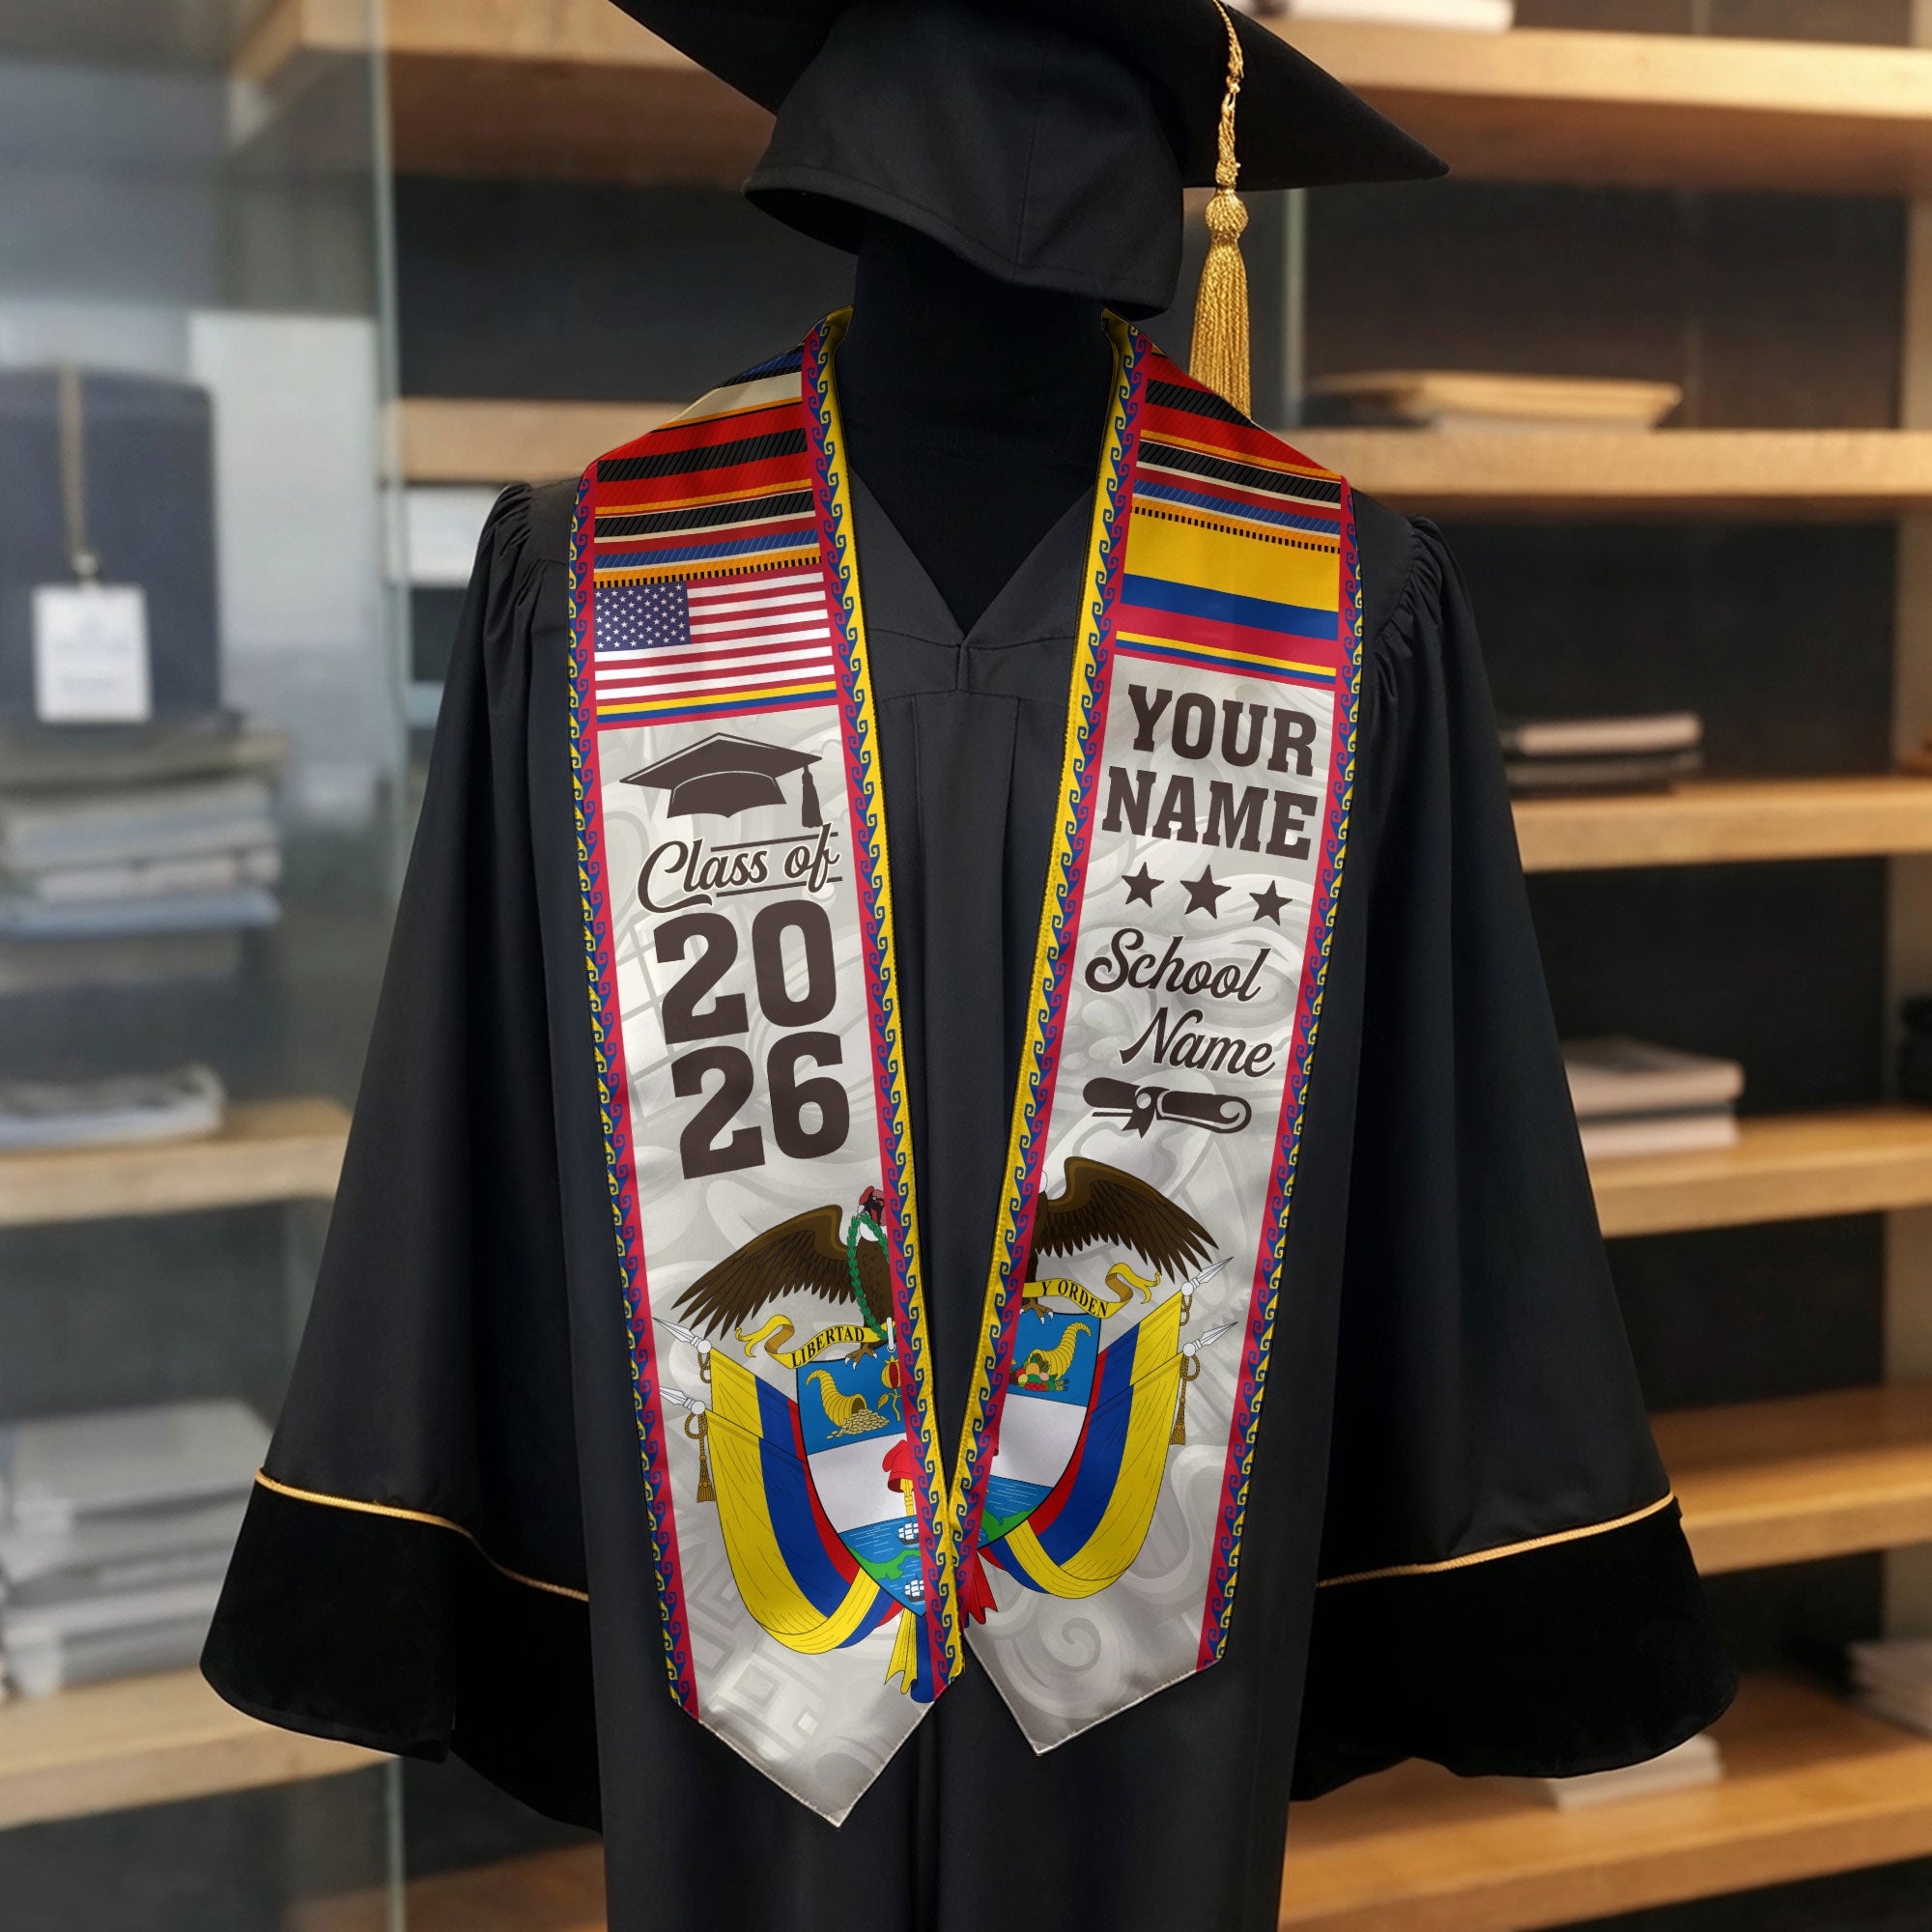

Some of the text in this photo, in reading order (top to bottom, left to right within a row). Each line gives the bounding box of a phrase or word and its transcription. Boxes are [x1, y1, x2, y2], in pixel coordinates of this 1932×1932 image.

[1128, 684, 1317, 777] YOUR
[1102, 766, 1318, 860] NAME
[638, 822, 840, 913] Class of
[654, 899, 837, 1044] 20
[1085, 928, 1270, 1002] School
[1119, 1007, 1275, 1077] Name
[671, 1031, 850, 1179] 26
[1041, 1280, 1109, 1317] Y ORDEN
[791, 1326, 865, 1368] LIBERTAD
